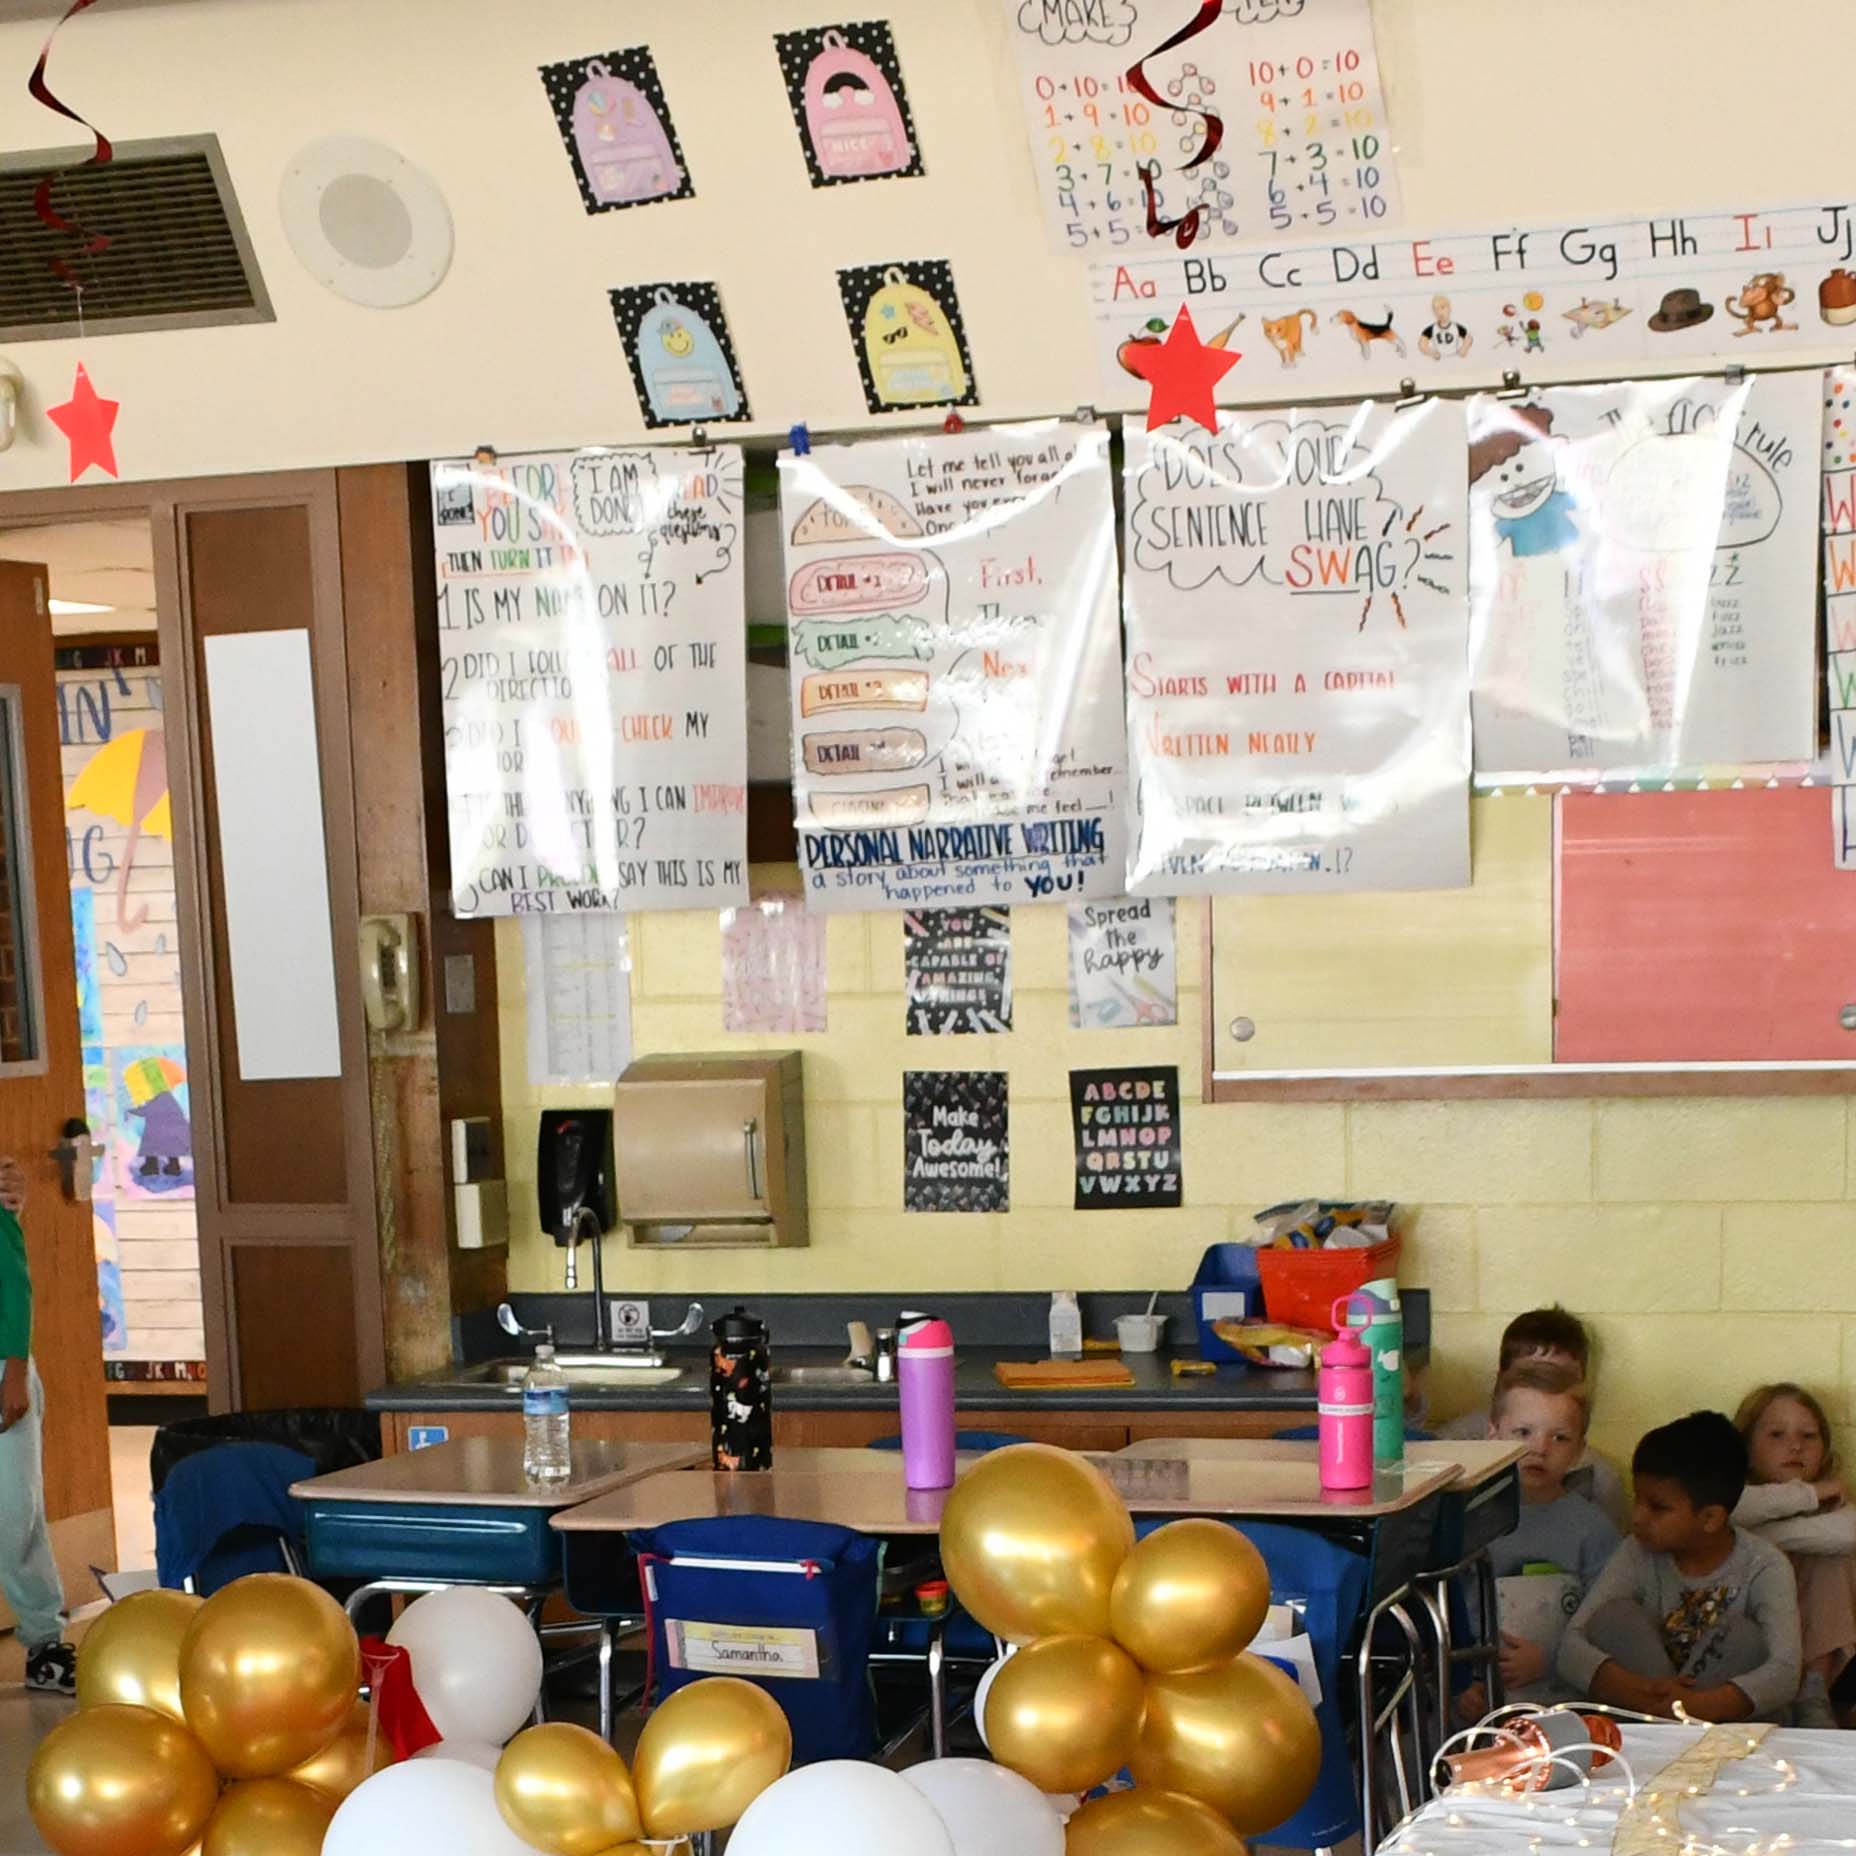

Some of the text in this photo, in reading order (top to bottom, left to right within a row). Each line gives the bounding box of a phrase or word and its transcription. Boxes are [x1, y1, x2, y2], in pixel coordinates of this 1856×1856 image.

[1043, 0, 1115, 29] MAKE
[1113, 265, 1158, 301] Aa
[1183, 257, 1228, 294] Bb
[1259, 252, 1304, 289] Cc
[1332, 245, 1380, 284] Dd
[1411, 241, 1455, 277] Ee
[1492, 232, 1530, 271] Ff
[1560, 228, 1618, 280] Gg
[1649, 218, 1698, 259] Hh
[1732, 212, 1773, 252] Ii
[1816, 205, 1854, 260] Jj
[907, 445, 1060, 479] Let me tell you all
[610, 463, 639, 495] AM
[477, 504, 520, 544] YOU
[1146, 495, 1368, 551] SENTENCE HAVE
[447, 547, 553, 573] THEN TURN IT
[1286, 536, 1422, 591] SWAG?
[464, 585, 521, 630] IS MY
[597, 580, 676, 619] ON IT?
[1225, 672, 1277, 695] WITH
[1294, 672, 1307, 693] A
[803, 829, 905, 869] PERSONAL
[908, 823, 1013, 862] NARRATIVE
[1021, 817, 1105, 855] WRITING
[618, 858, 742, 890] SAY THIS IS MY
[812, 852, 1106, 891] a story about something that
[884, 871, 1086, 902] happened to YOU!
[511, 889, 556, 914] BEST
[1084, 899, 1152, 928] Spread
[1105, 927, 1137, 949] the
[1084, 946, 1165, 976] happy
[932, 1104, 979, 1129] Make
[916, 1128, 999, 1163] Today
[912, 1155, 1002, 1179] Awesome!
